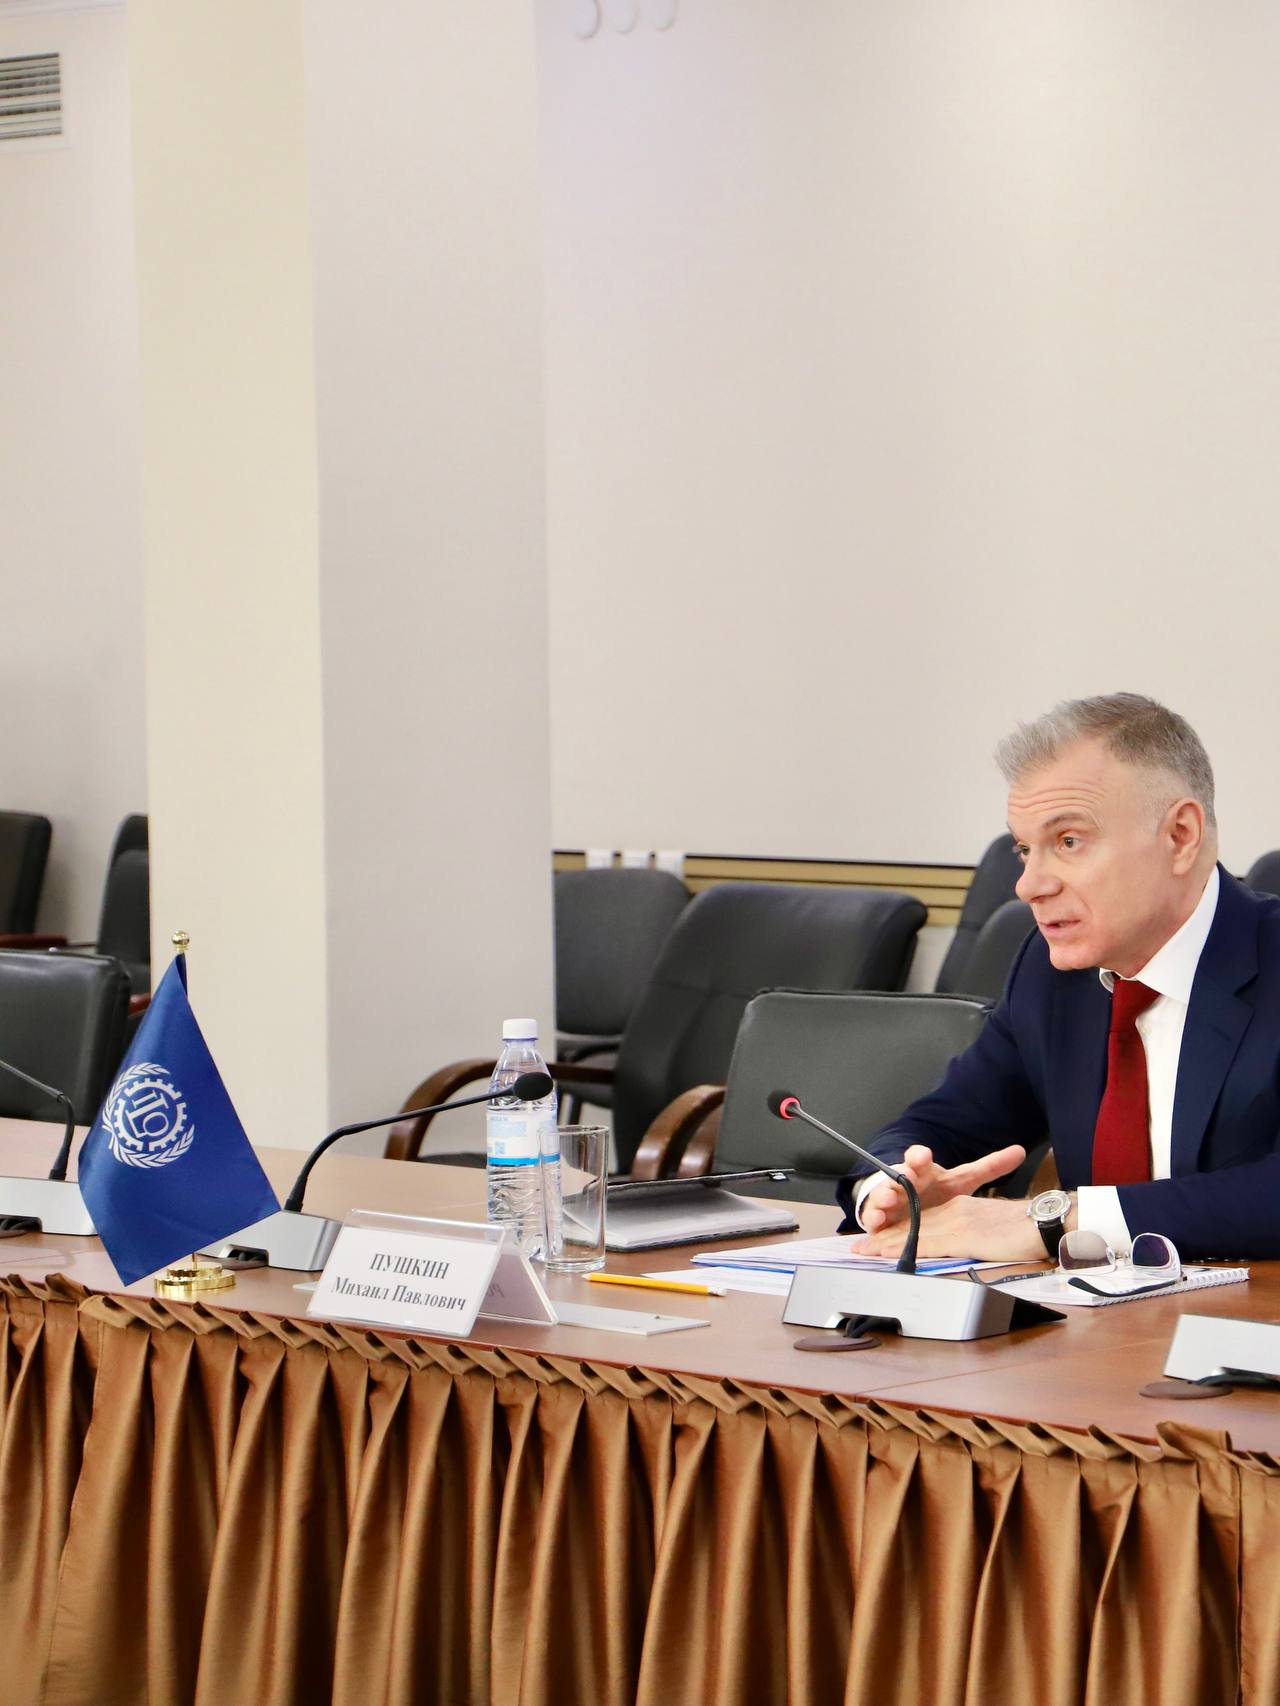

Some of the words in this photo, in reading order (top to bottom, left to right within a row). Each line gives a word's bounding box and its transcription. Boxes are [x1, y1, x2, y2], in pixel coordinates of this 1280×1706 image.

[125, 1089, 169, 1138] ILO
[370, 1253, 450, 1279] ПУШКИН
[332, 1277, 389, 1299] Михаил
[392, 1285, 466, 1311] Павлович
